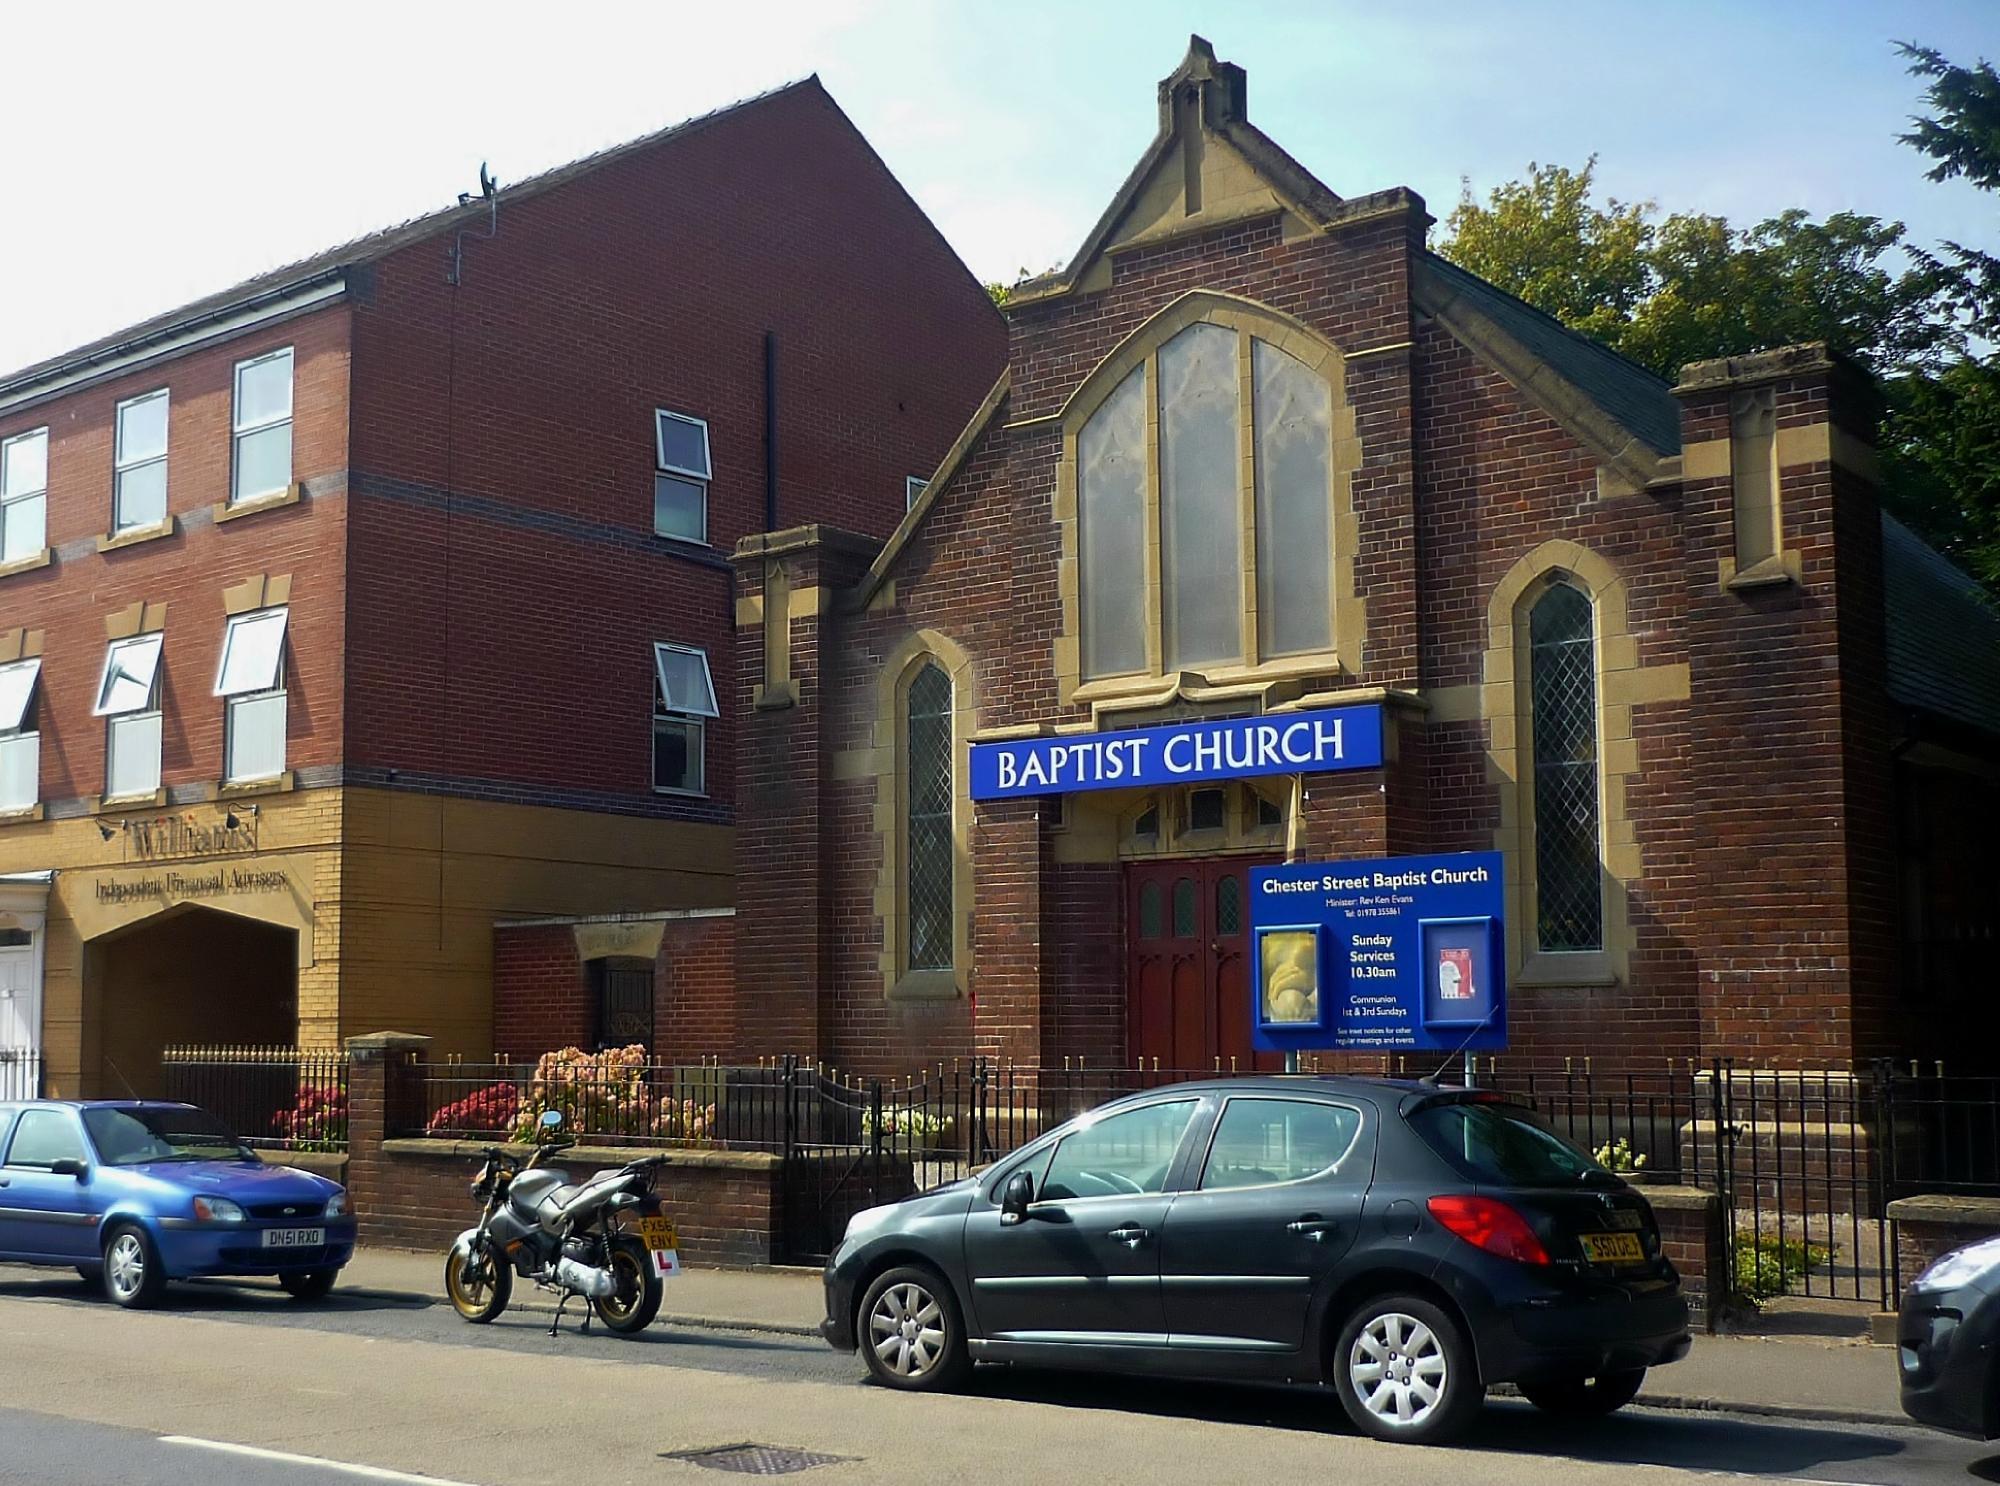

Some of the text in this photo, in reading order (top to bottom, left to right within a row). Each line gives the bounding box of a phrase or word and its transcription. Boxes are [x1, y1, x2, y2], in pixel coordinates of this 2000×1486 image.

[997, 719, 1344, 789] BAPTIST CHURCH
[131, 814, 256, 857] Williams
[95, 875, 162, 899] Independent
[166, 868, 224, 893] Financial
[1262, 867, 1488, 894] Chester Street Baptist Church
[1325, 894, 1414, 908] Minister: Rev Ken Evans
[1356, 908, 1377, 918] 01978
[1351, 934, 1393, 948] Sunday
[1350, 949, 1395, 963] Services
[1351, 966, 1396, 979] 10.30am
[1350, 994, 1397, 1004] Communion
[1342, 1005, 1407, 1018] 1st & 3rd Sundays
[1385, 1026, 1394, 1034] for
[1395, 1026, 1412, 1034] other
[1357, 1037, 1382, 1046] meetings
[270, 1230, 319, 1245] DN51 RXO
[656, 1251, 673, 1270] L
